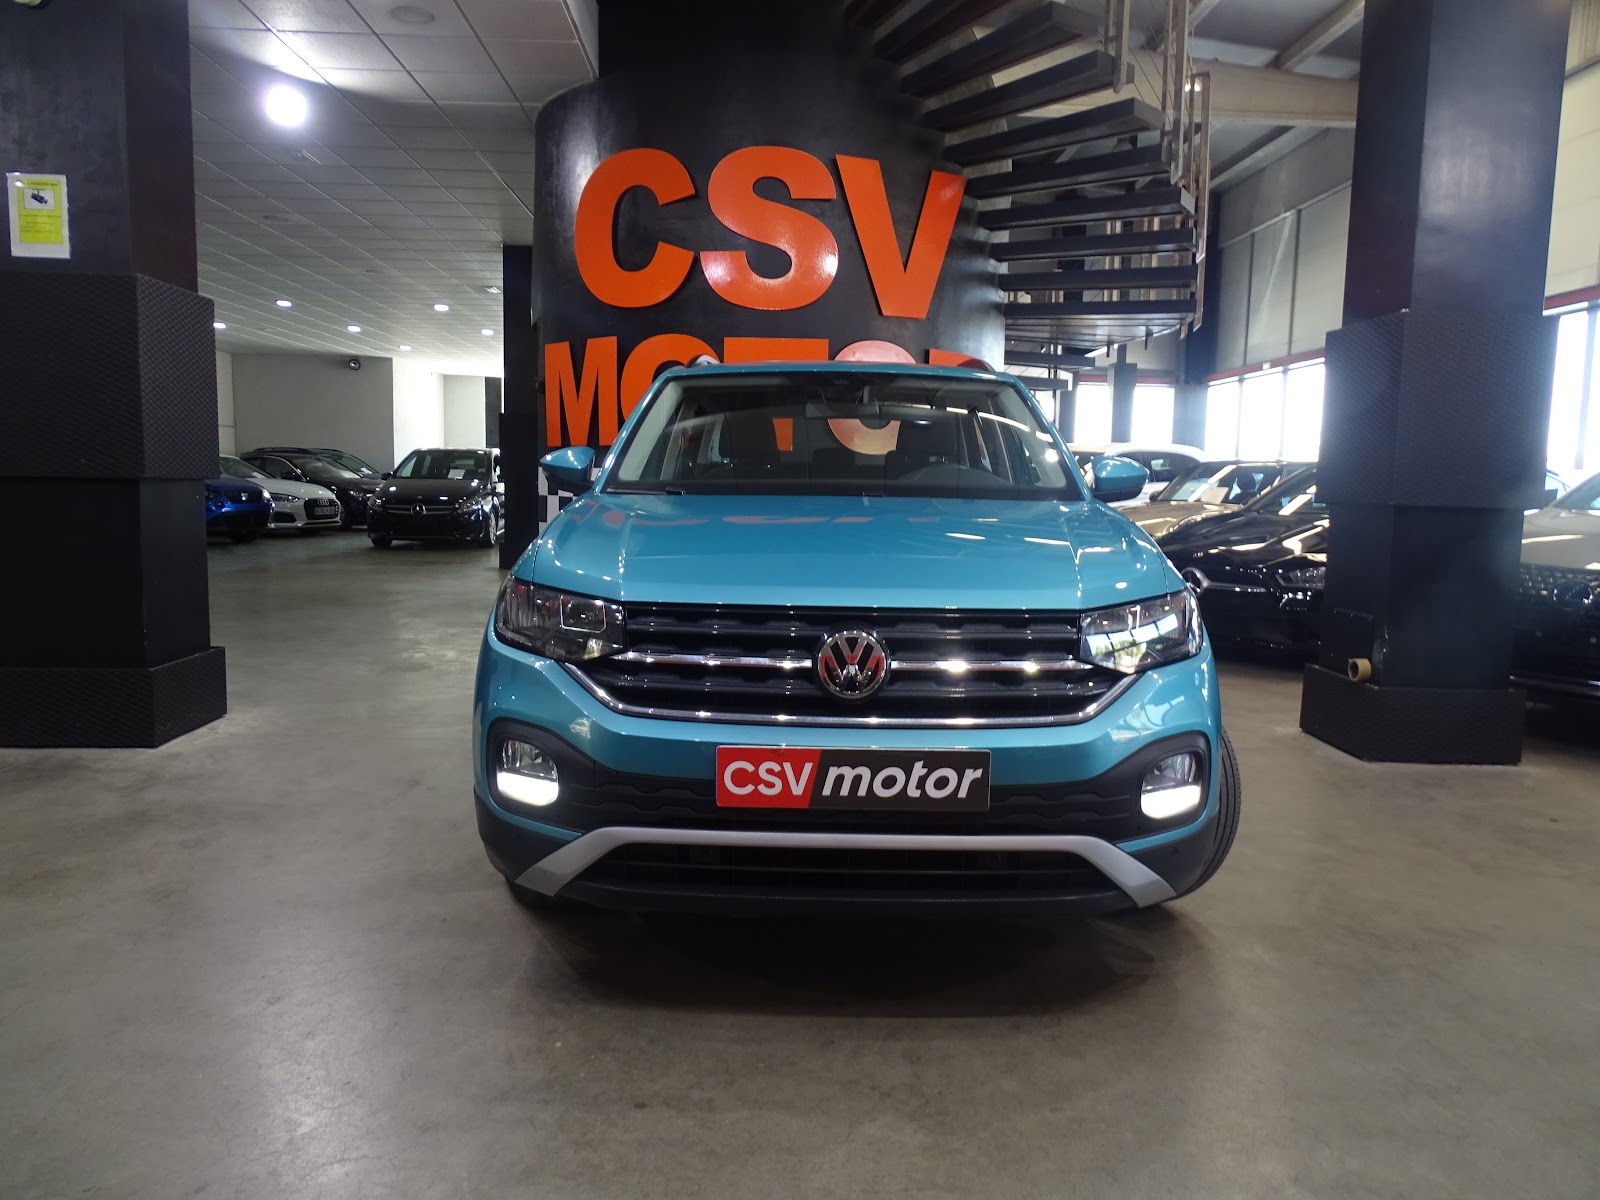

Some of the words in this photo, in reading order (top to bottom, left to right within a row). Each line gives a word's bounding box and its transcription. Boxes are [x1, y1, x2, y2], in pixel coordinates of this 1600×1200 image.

[574, 145, 967, 319] CSV
[723, 760, 813, 796] CSV
[821, 760, 983, 799] motor
